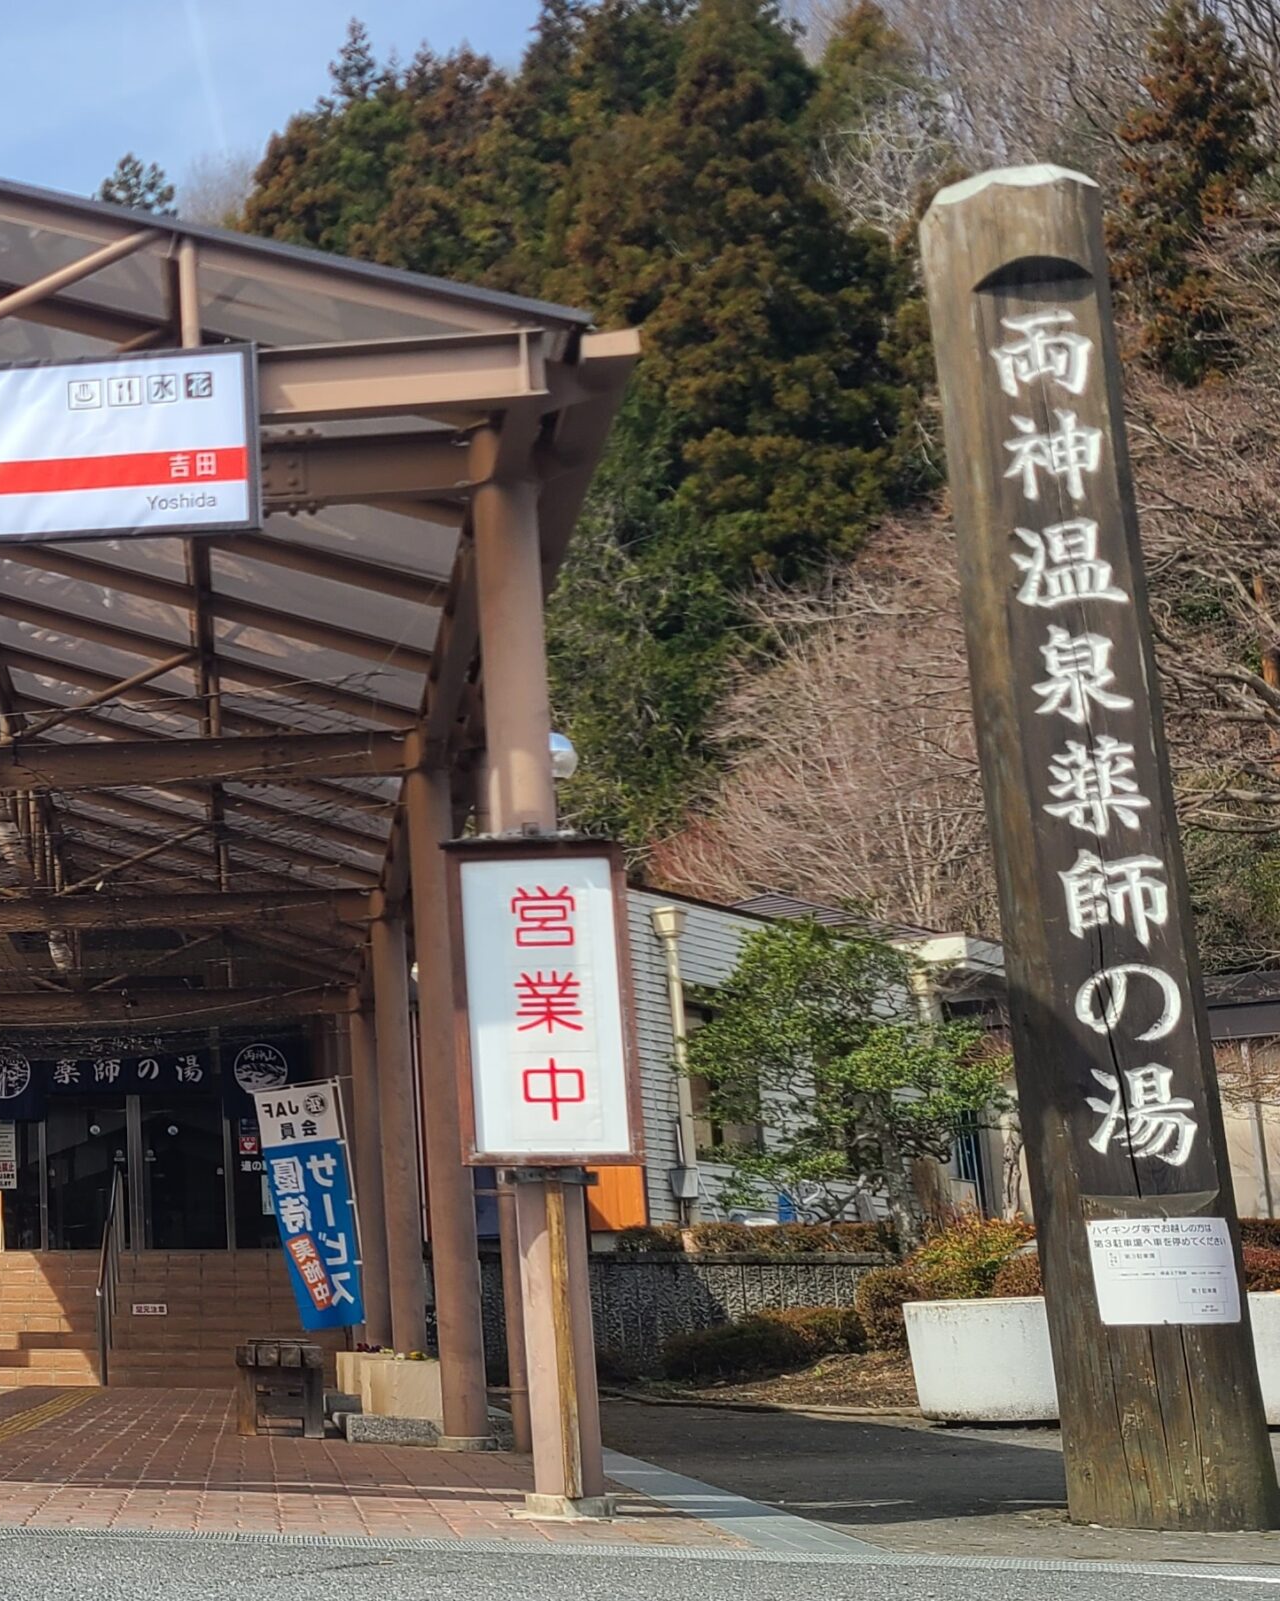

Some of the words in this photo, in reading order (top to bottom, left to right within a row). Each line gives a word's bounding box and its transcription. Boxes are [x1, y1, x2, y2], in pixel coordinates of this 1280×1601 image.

[169, 452, 216, 478] 吉田
[147, 493, 217, 511] Yoshida
[990, 309, 1198, 1167] 両神温泉薬師の湯
[511, 885, 585, 1121] 営業中
[53, 1055, 204, 1085] 薬師の湯
[240, 1160, 269, 1173] 道の
[1092, 1223, 1212, 1234] ハイキング等でお越しの方は
